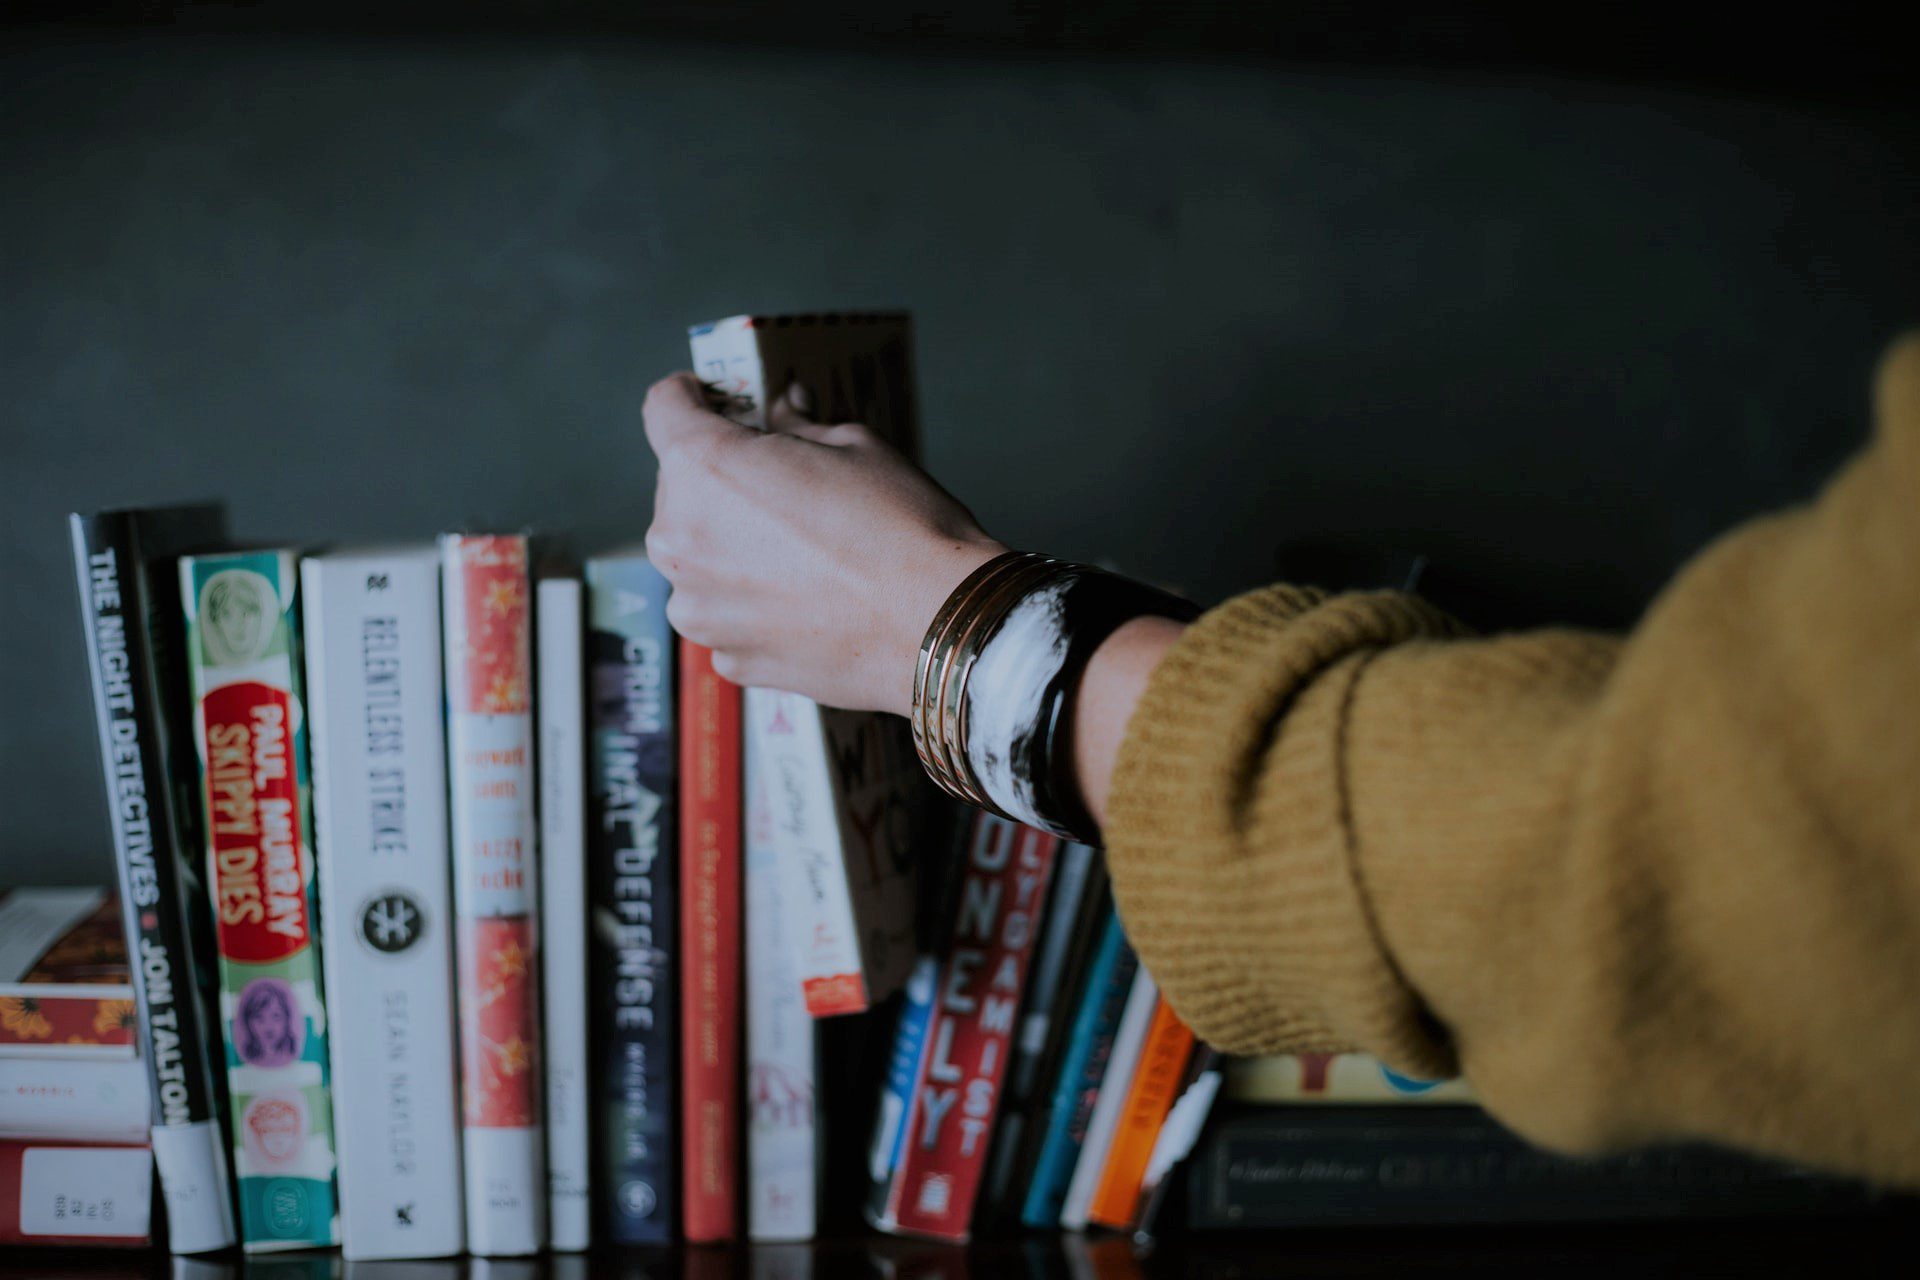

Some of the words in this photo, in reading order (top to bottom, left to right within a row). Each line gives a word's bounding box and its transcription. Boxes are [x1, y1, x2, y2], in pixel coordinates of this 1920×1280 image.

[89, 547, 121, 612] THE
[97, 613, 136, 715] NIGHT
[363, 616, 402, 753] RELENTLESS
[208, 722, 258, 837] SKIPPY
[248, 702, 288, 792] PAUL
[114, 718, 160, 906] DETECTIVES
[369, 767, 407, 854] STRIKE
[217, 847, 266, 926] DIES
[257, 797, 305, 940] MURRAY
[141, 938, 173, 1004] JON
[614, 846, 655, 1029] DEFENSE
[920, 811, 1016, 1151] ONELY
[384, 988, 409, 1061] SEAN
[958, 829, 1042, 1158] LYGAMIST
[151, 1007, 190, 1126] TALTON
[387, 1072, 415, 1175] NAYLOR
